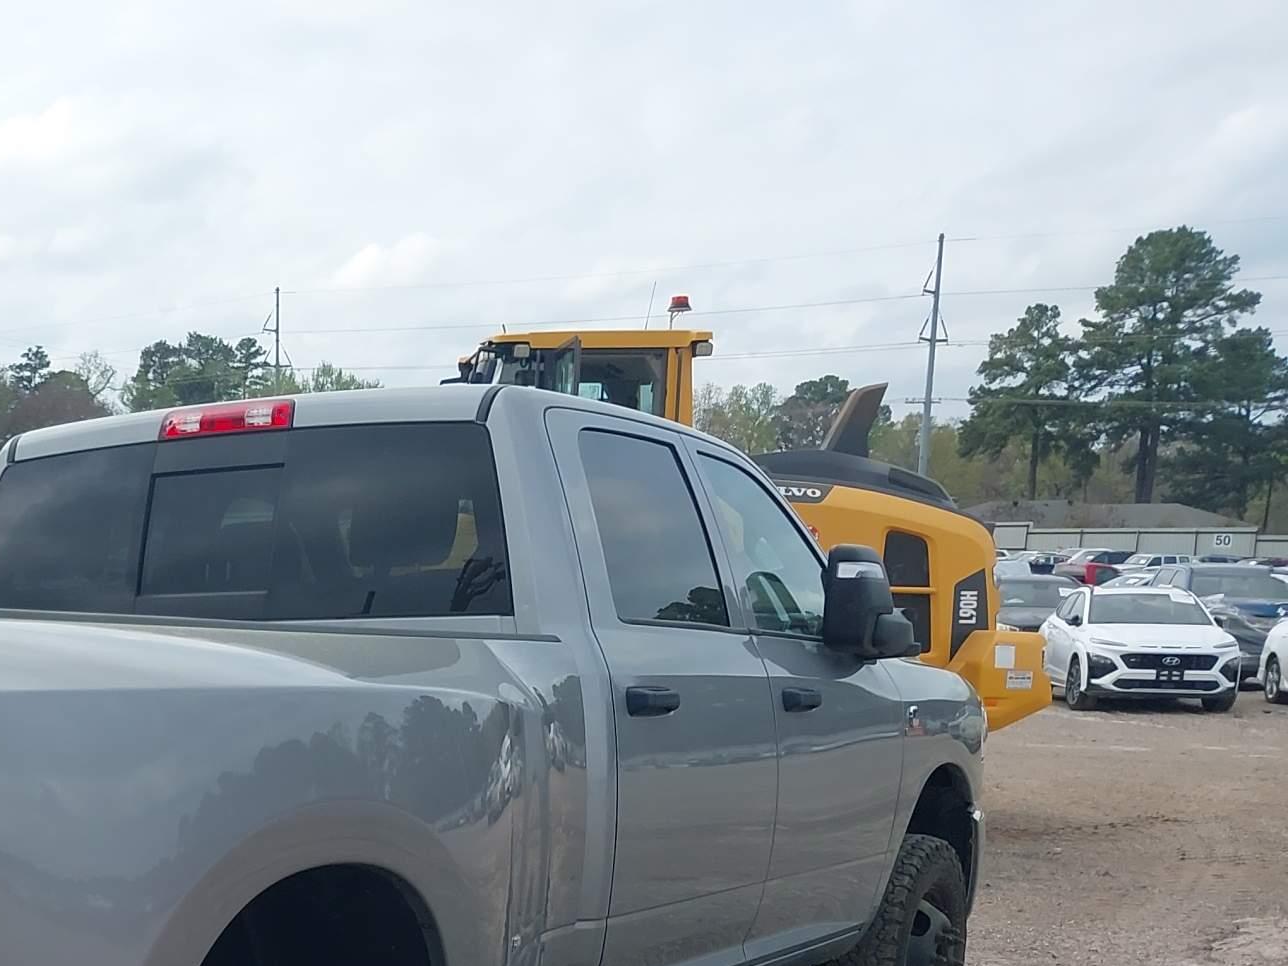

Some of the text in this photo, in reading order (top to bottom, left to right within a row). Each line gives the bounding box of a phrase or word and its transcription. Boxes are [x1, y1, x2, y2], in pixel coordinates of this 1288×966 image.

[776, 487, 822, 498] LVO
[1215, 535, 1231, 546] 50
[958, 590, 979, 625] L90H
